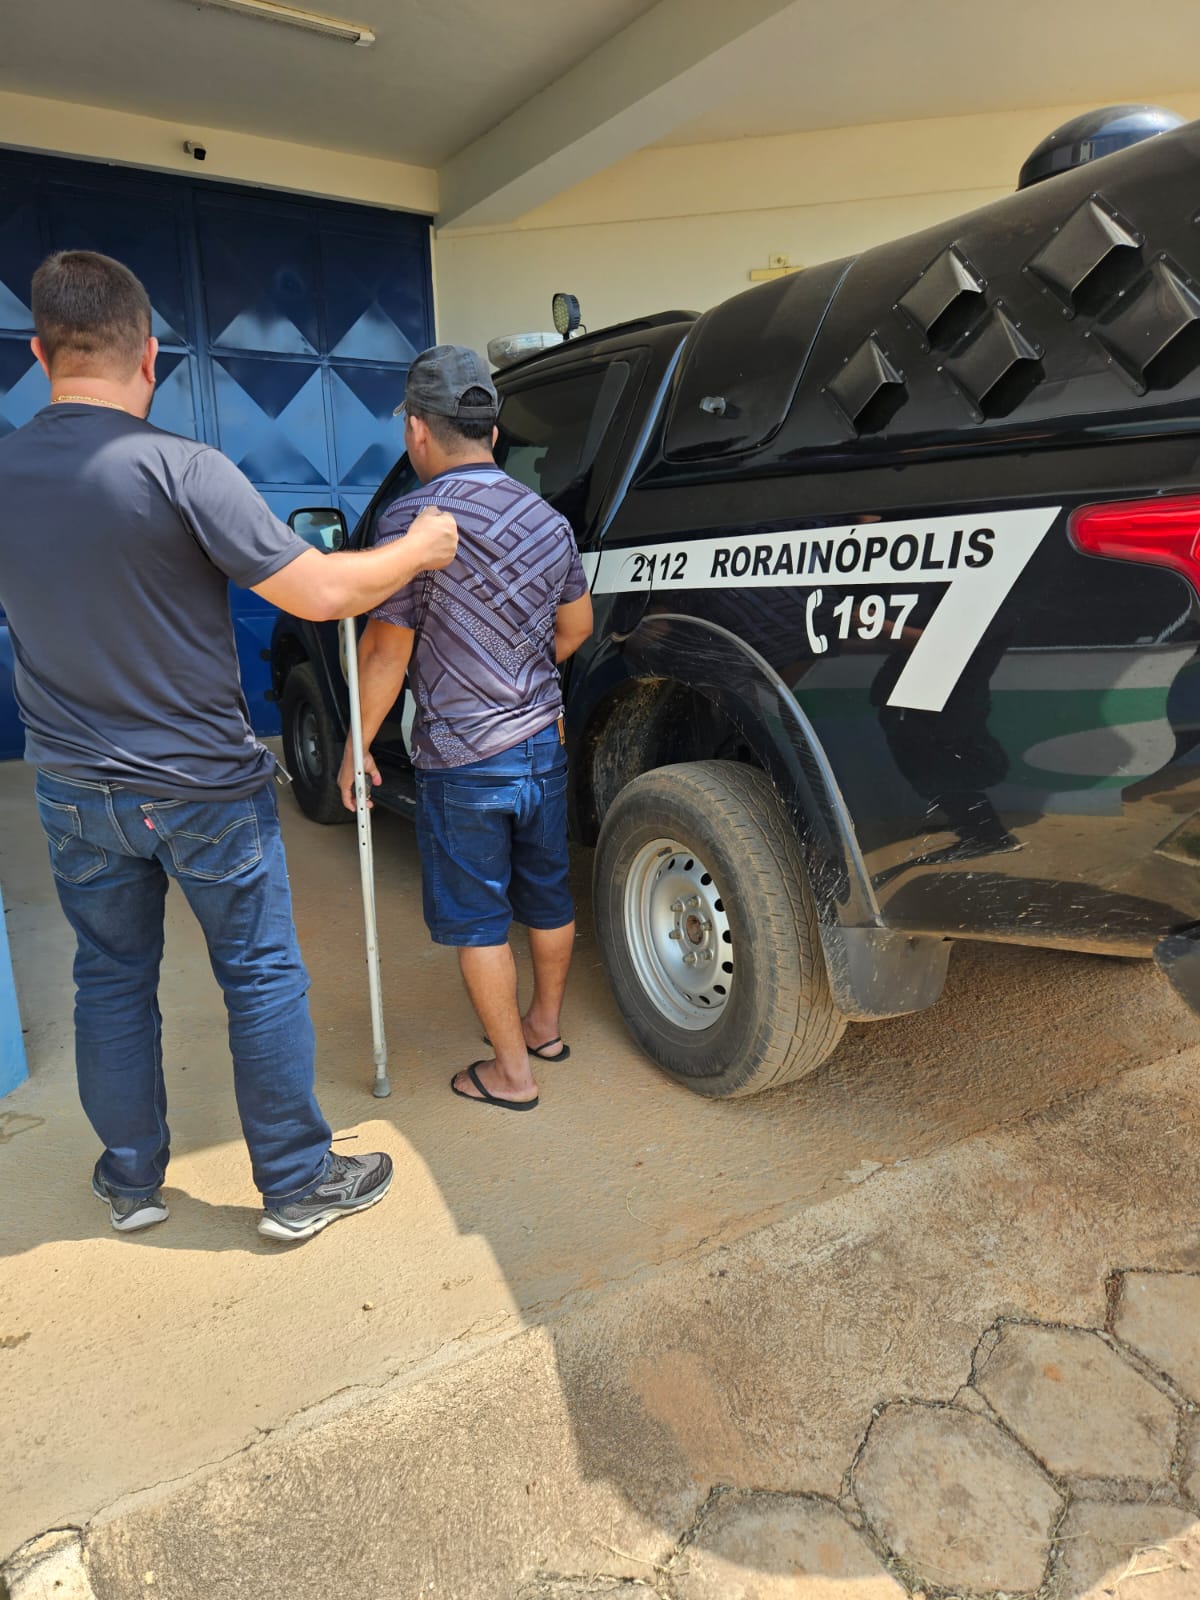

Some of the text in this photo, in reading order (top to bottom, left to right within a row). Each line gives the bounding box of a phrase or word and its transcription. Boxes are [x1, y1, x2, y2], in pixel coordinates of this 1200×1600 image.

[630, 528, 995, 583] 2112 RORAINÓPOLIS
[833, 593, 919, 640] 197
